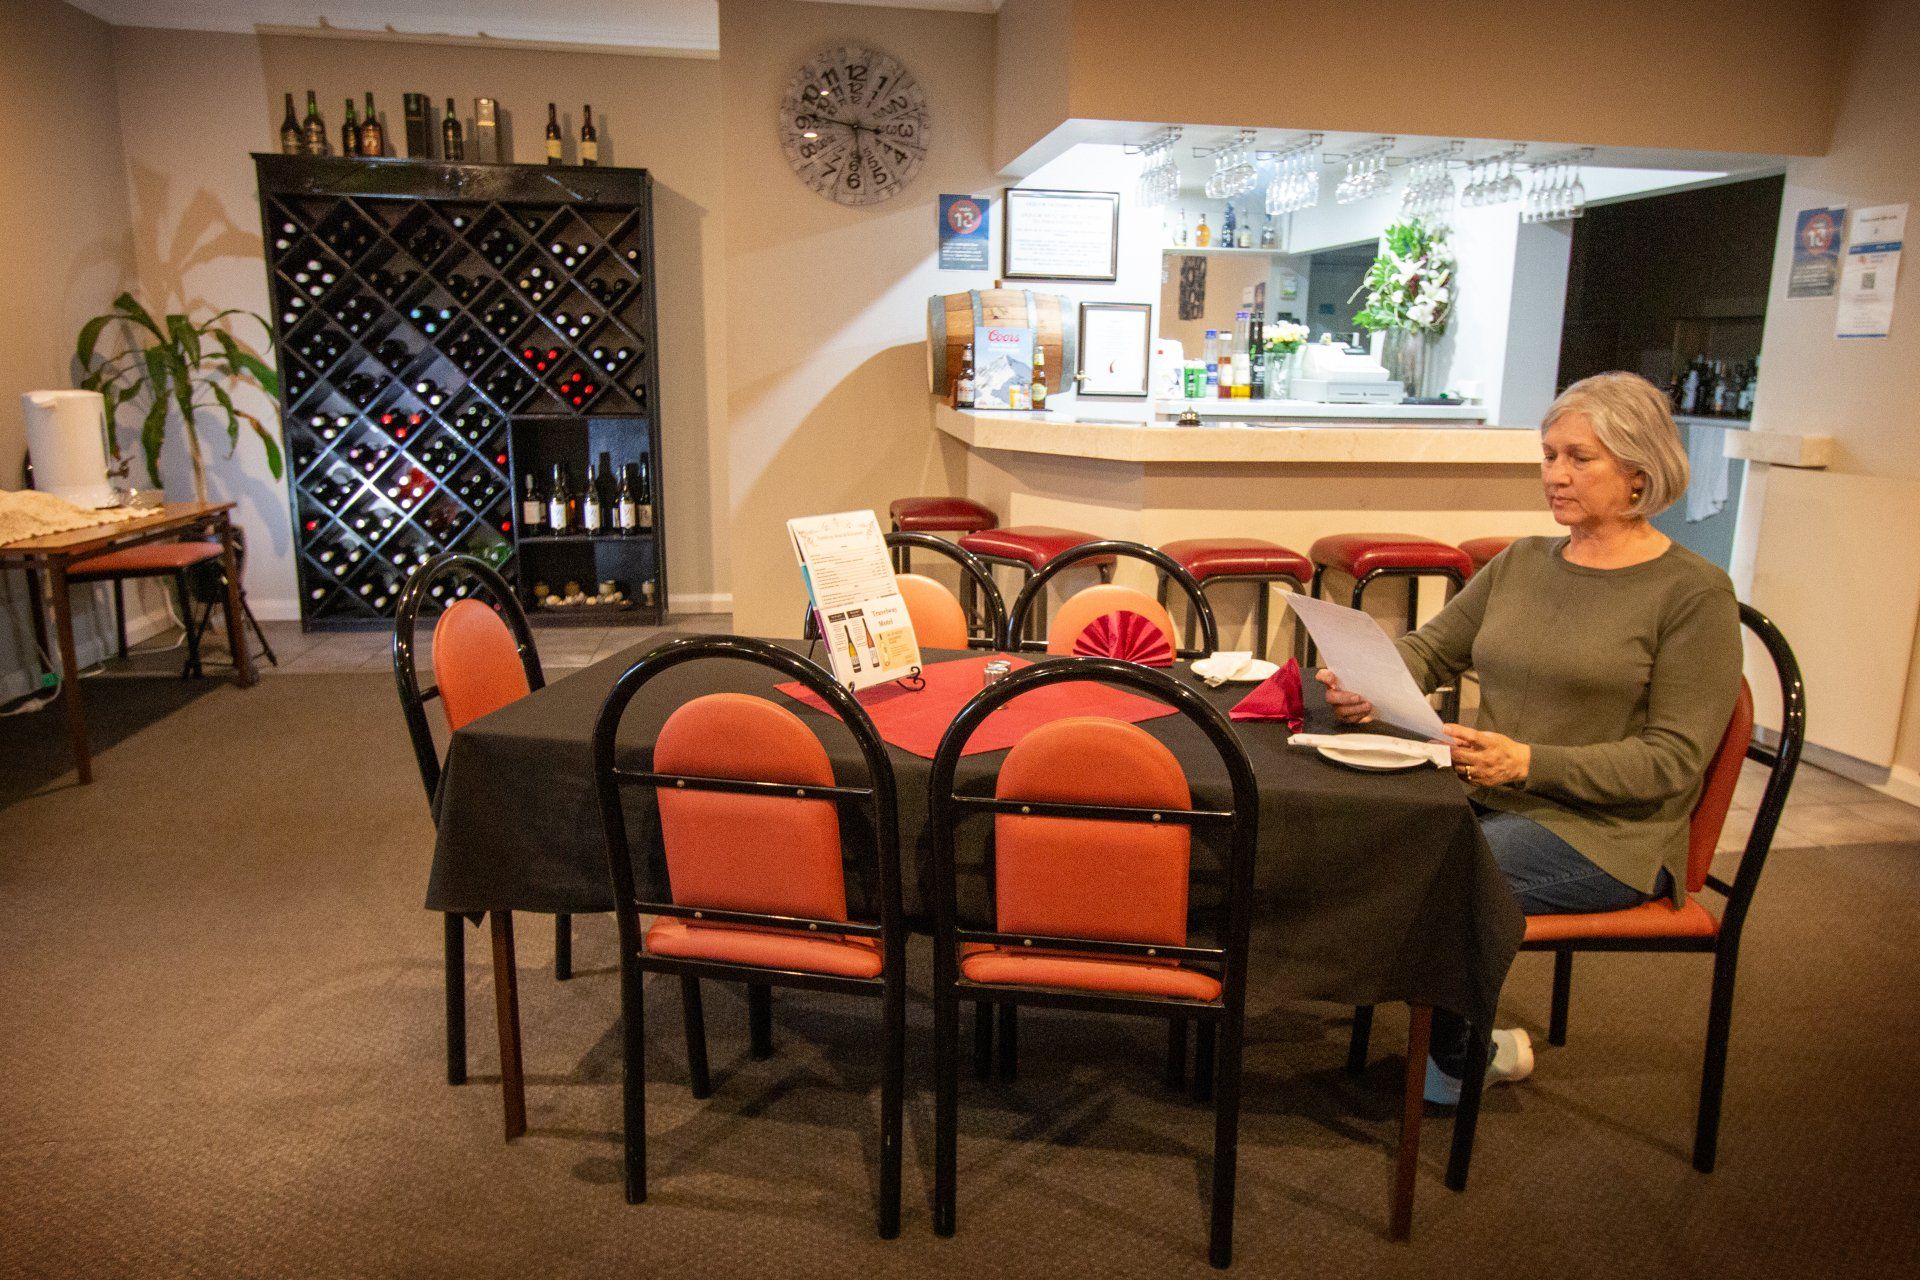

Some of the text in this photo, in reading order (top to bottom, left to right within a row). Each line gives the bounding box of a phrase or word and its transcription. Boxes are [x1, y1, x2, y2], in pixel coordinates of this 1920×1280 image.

[821, 68, 840, 87] 11
[845, 64, 868, 81] 12
[879, 75, 889, 91] 1
[801, 83, 820, 105] 10
[890, 95, 908, 109] 2
[795, 115, 811, 130] 9
[898, 123, 914, 138] 3
[800, 143, 818, 159] 8
[894, 149, 908, 164] 4
[821, 162, 838, 177] 7
[872, 166, 888, 185] 5
[847, 172, 861, 190] 6
[987, 329, 1021, 343] Coors
